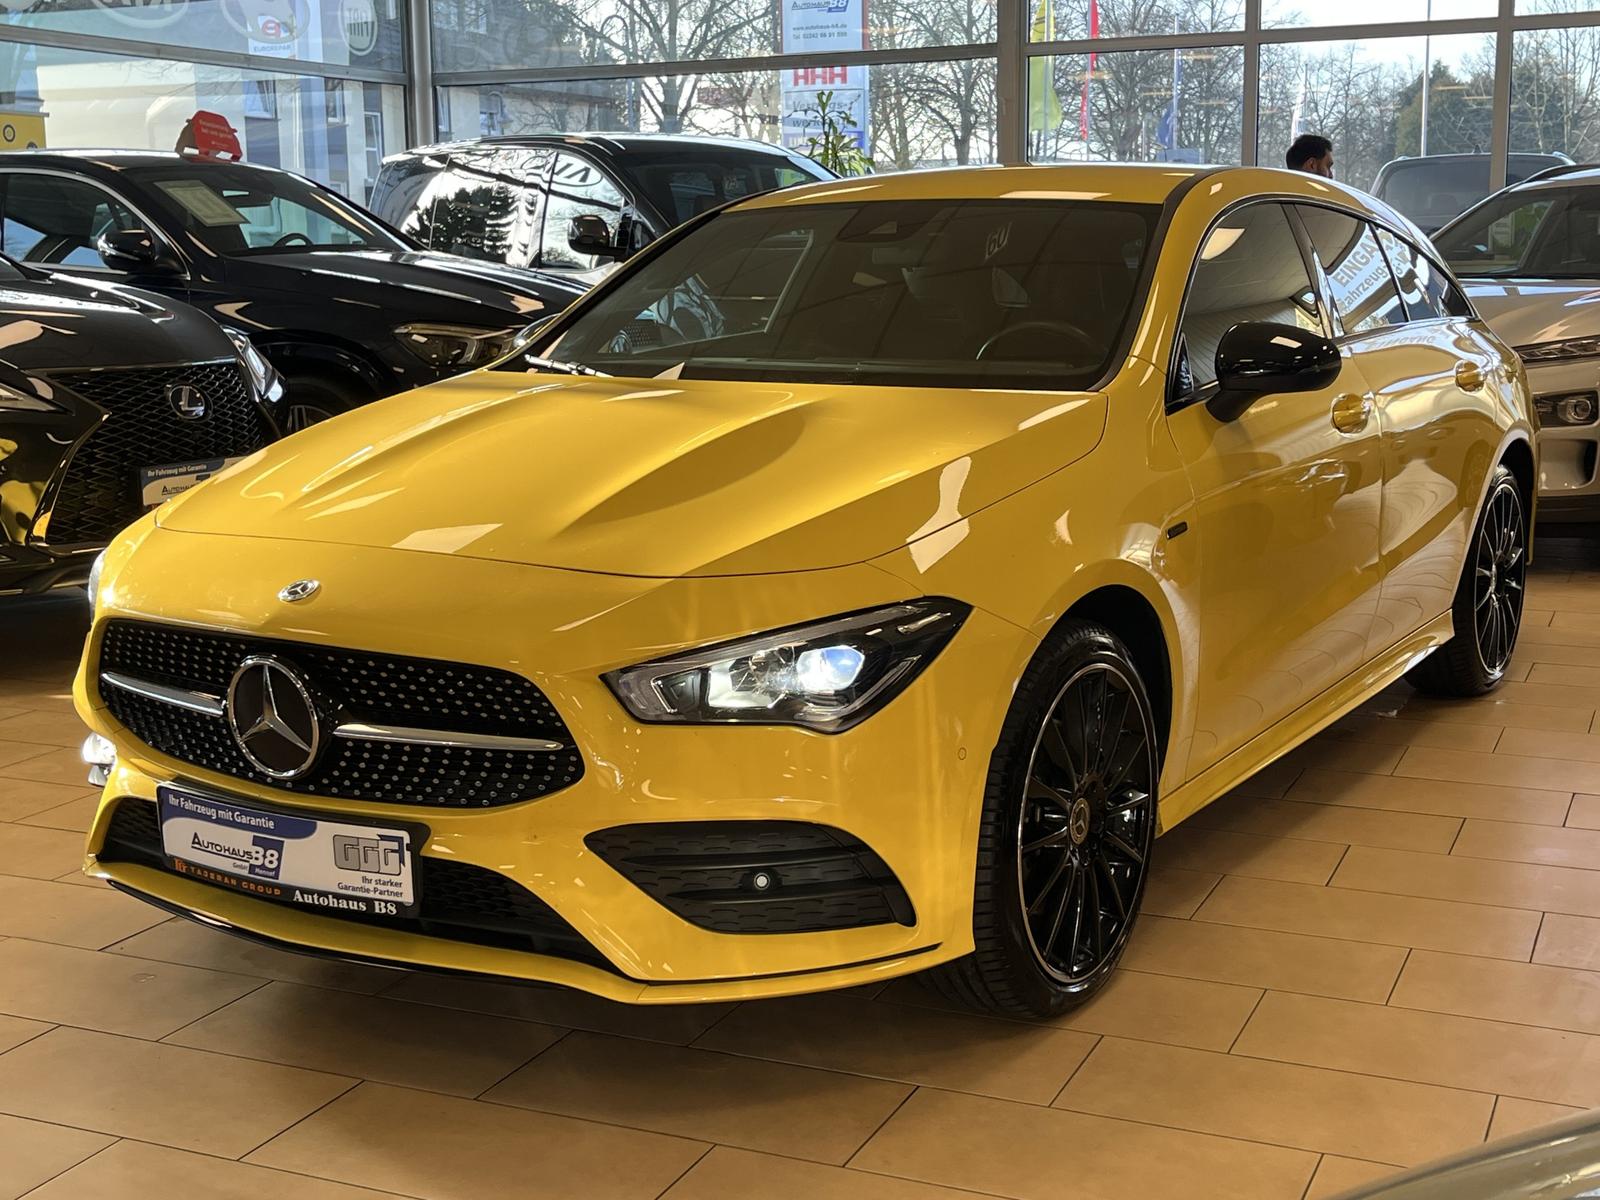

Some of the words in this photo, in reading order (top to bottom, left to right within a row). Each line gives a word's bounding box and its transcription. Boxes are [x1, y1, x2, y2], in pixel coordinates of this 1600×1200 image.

[168, 793, 179, 807] Ihr
[180, 798, 217, 820] Fahrzeug
[218, 809, 233, 821] mit
[233, 811, 275, 830] Garantie
[191, 832, 254, 860] AUTOHAUS
[337, 881, 404, 898] Garantie-Partner
[361, 875, 373, 885] Ihr
[374, 878, 403, 889] starker
[293, 888, 367, 913] Autohaus
[374, 900, 398, 916] B8
